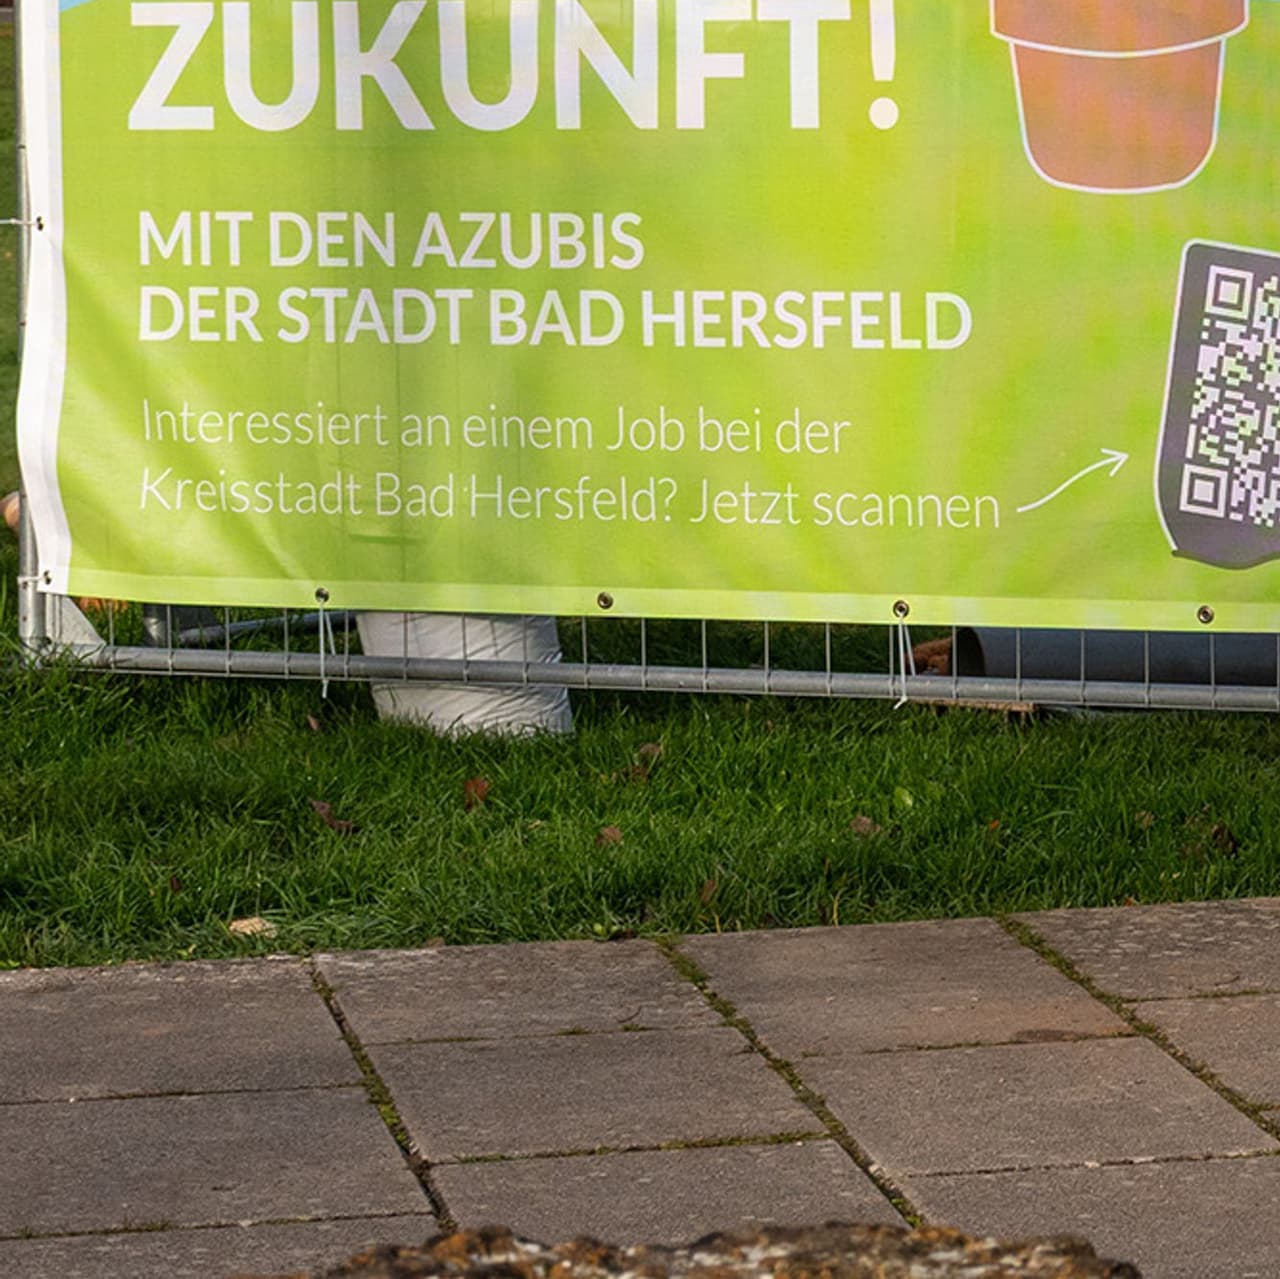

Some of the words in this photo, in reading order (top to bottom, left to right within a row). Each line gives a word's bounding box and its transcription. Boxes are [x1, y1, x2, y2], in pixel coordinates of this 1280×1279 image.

[140, 211, 253, 267] MIT
[270, 212, 395, 268] DEN
[412, 212, 645, 270] AZUBIS
[139, 286, 263, 343] DER
[278, 287, 473, 345] STADT
[489, 289, 625, 347] BAD
[642, 290, 973, 350] HERSFELD
[142, 399, 388, 448] Interessiert
[401, 413, 451, 448] an
[462, 404, 594, 451] einem
[607, 405, 686, 453] Job
[697, 406, 763, 454] bei
[775, 407, 852, 456] der
[141, 467, 364, 517] Kreisstadt
[374, 471, 455, 520] Bad
[468, 473, 679, 523] Hersfeld?
[689, 477, 800, 527] Jetzt
[812, 491, 1001, 530] scannen
